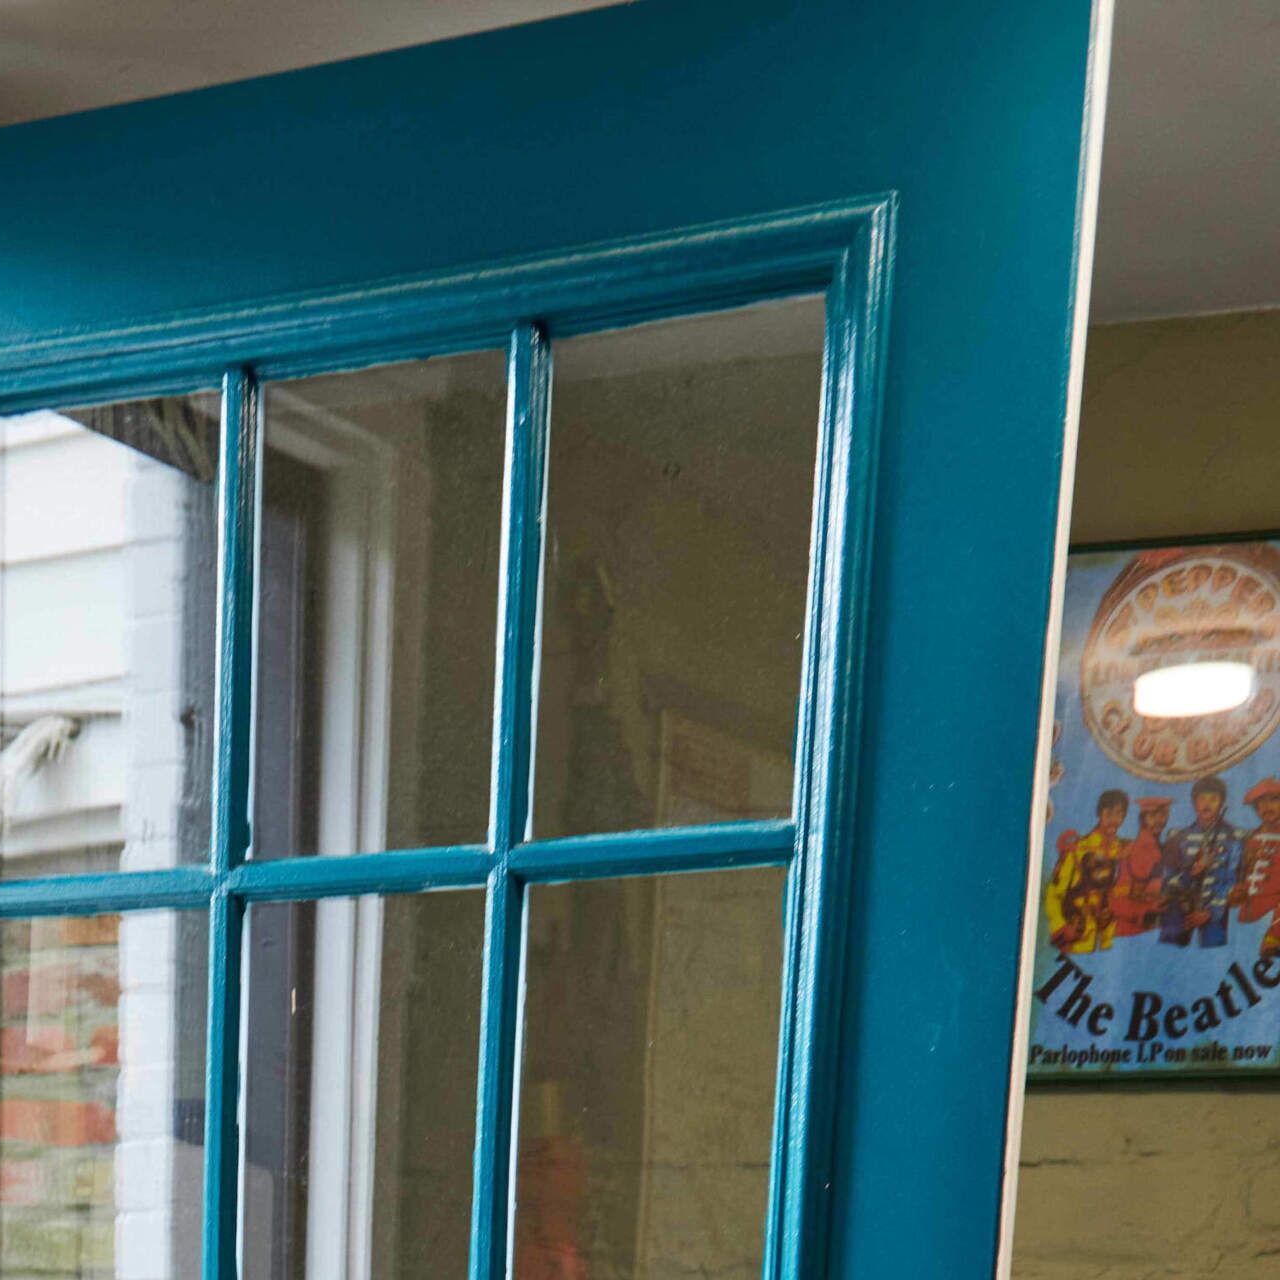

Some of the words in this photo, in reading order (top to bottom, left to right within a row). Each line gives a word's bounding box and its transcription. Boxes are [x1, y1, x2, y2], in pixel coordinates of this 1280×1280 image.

[1034, 953, 1115, 1036] The
[1123, 953, 1280, 1042] Beatle
[1028, 1043, 1132, 1069] Parlophone
[1165, 1047, 1187, 1062] on
[1232, 1045, 1273, 1061] now
